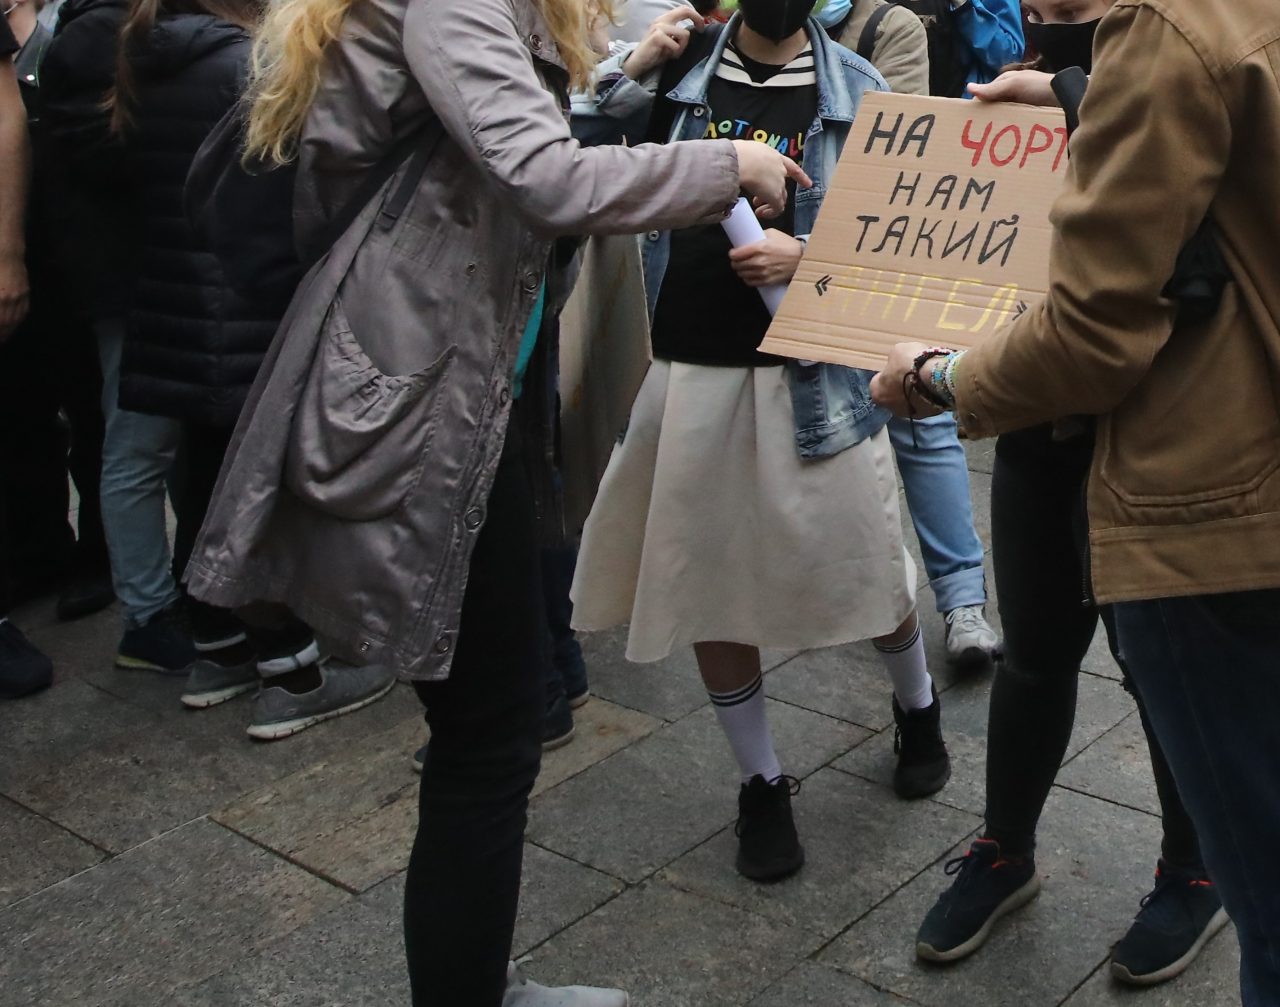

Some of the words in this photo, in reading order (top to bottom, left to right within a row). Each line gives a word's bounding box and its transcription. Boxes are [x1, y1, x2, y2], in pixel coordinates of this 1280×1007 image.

[864, 111, 935, 158] НА
[889, 171, 996, 212] НАМ
[855, 214, 1019, 267] ТАКИЙ
